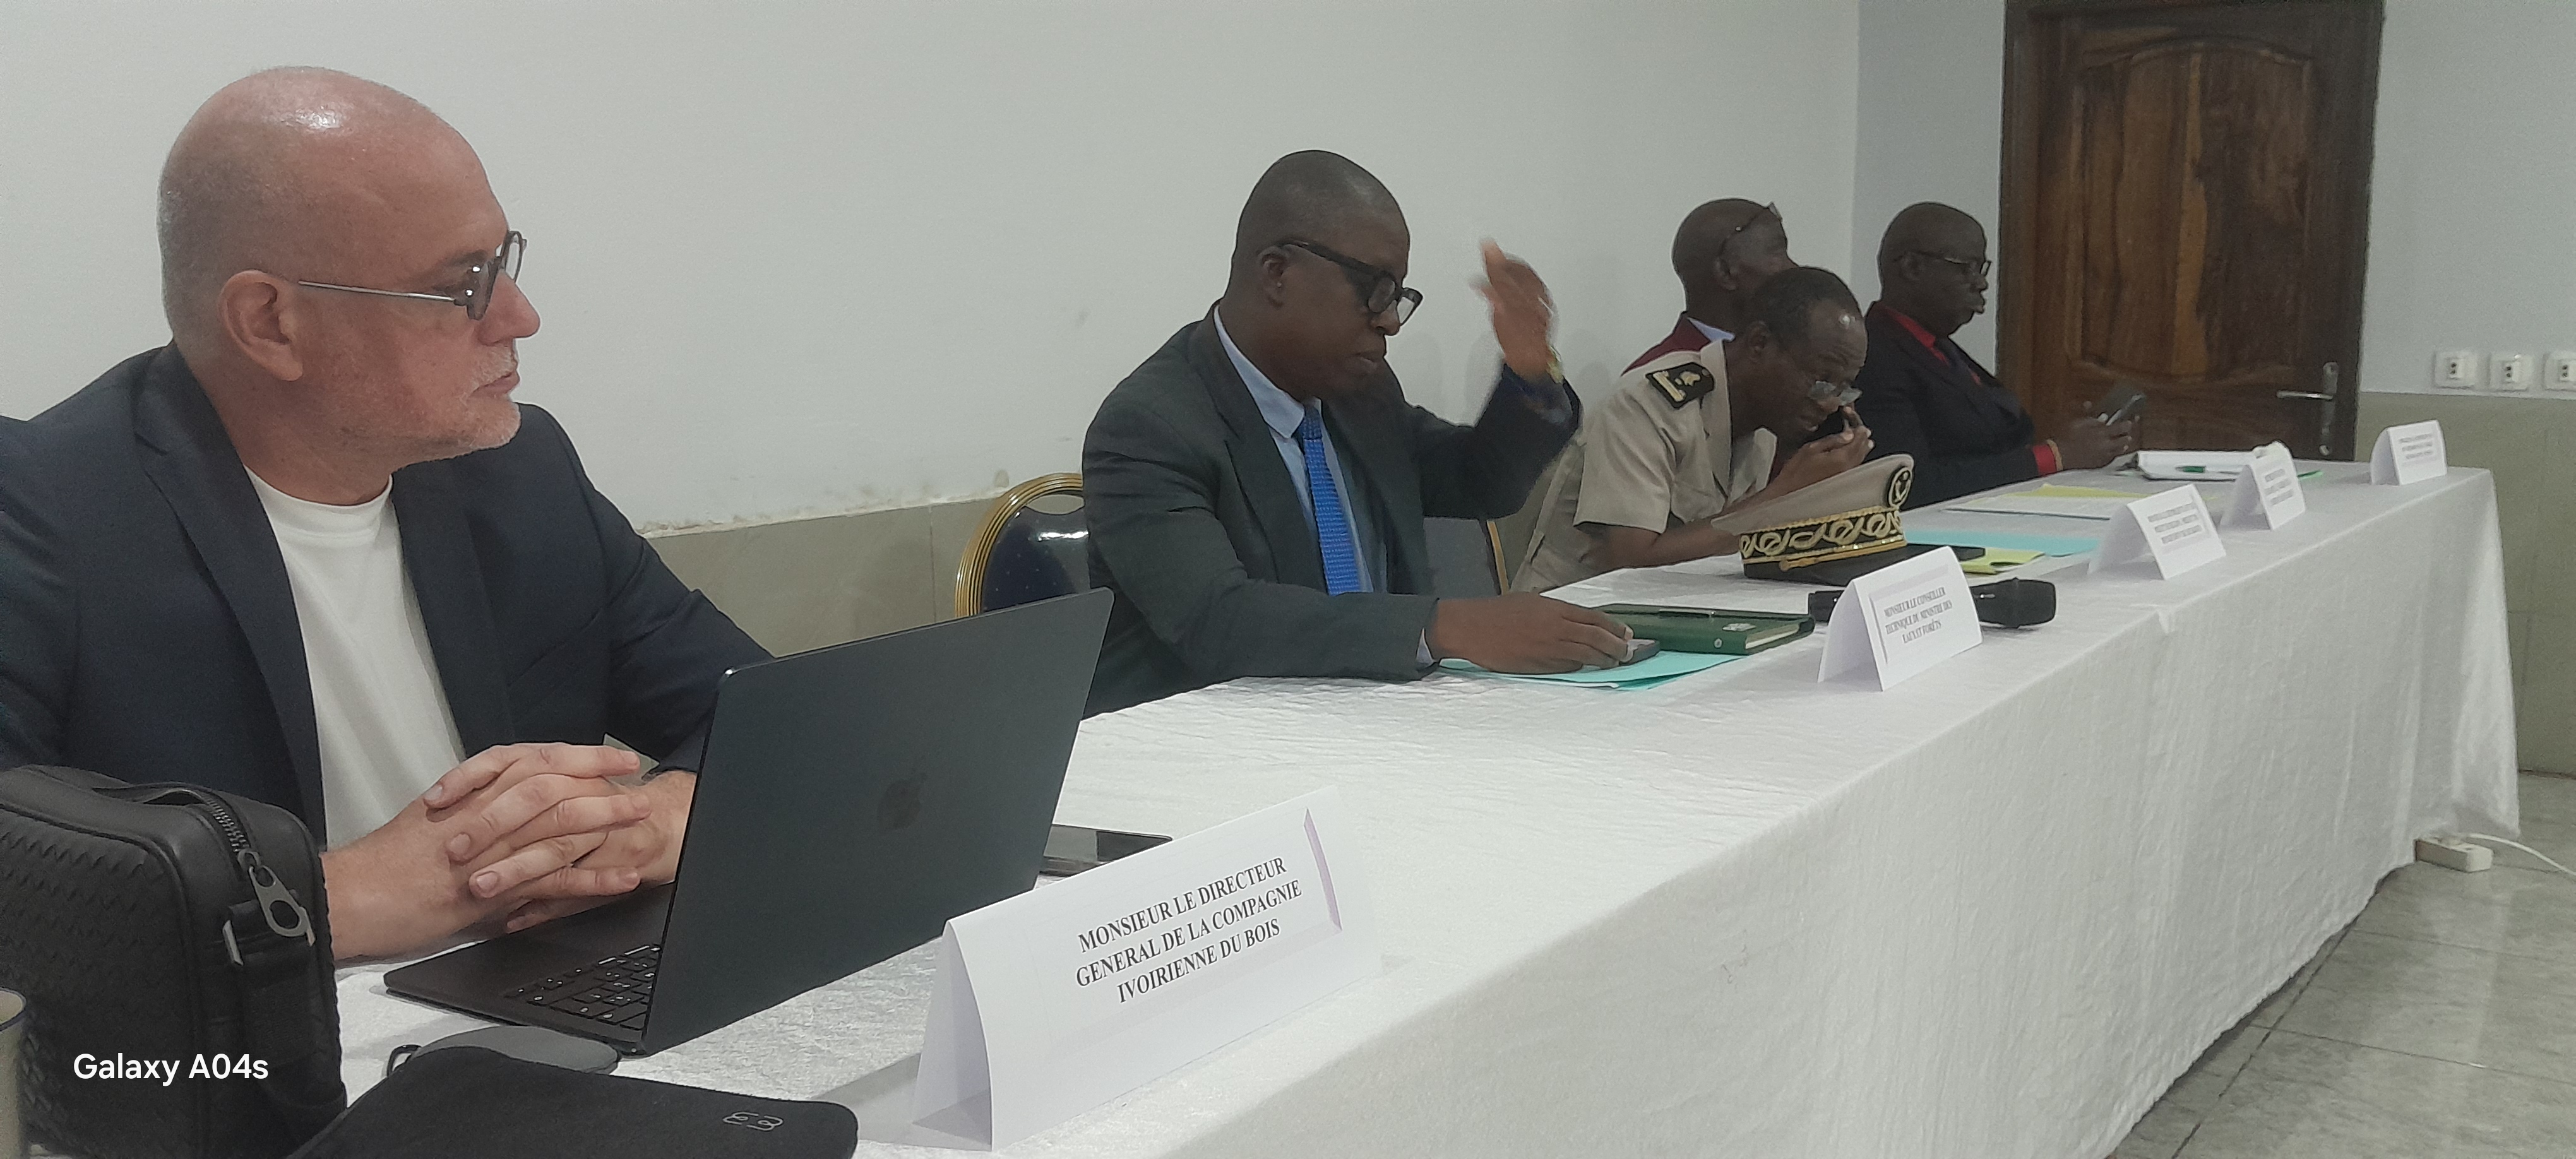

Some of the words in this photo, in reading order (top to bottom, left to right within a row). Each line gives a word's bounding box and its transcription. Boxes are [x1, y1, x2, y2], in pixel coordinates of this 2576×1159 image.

[1076, 939, 1161, 987] GENERAL
[1162, 927, 1186, 951] DE
[1187, 917, 1210, 941] LA
[1212, 880, 1302, 930] COMPAGNIE
[1078, 902, 1172, 953] MONSIEUR
[1174, 892, 1197, 914] LE
[1198, 857, 1287, 905] DIRECTEUR
[1117, 945, 1218, 1003] IVOIRIENNE
[1220, 934, 1242, 958] DU
[1246, 918, 1280, 949] BOIS
